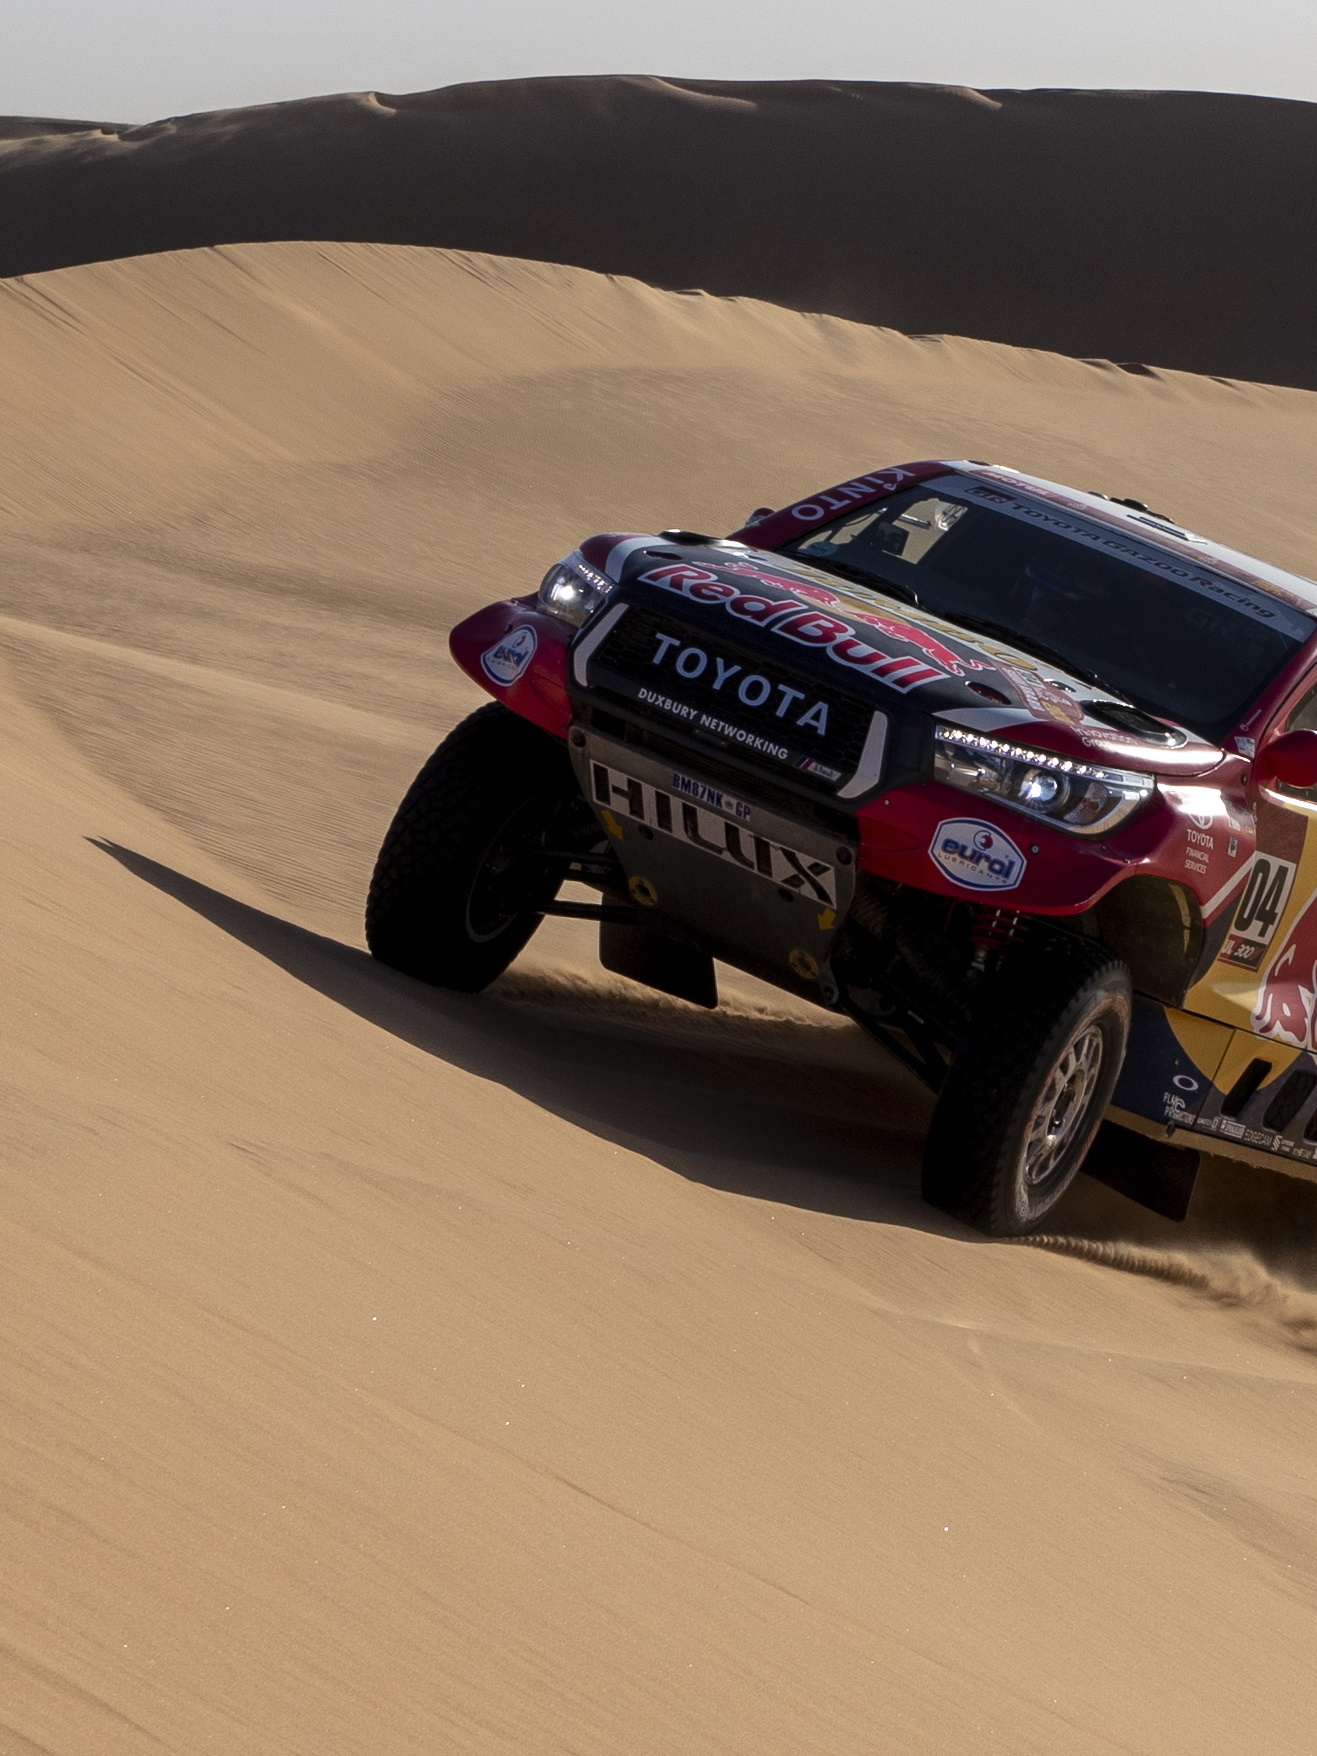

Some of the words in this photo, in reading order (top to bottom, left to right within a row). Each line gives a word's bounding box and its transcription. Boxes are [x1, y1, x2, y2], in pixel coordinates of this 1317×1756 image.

[791, 467, 916, 520] KINTO
[1011, 502, 1101, 541] TOYOTA
[1102, 540, 1190, 578] GAZOO
[1189, 576, 1277, 619] Racing
[638, 564, 808, 627] Red
[771, 611, 951, 693] Bull
[651, 633, 830, 737] TOYOTA
[637, 687, 699, 720] DUXBURY
[699, 713, 789, 760] NETWORKING
[672, 772, 725, 810] BM87NK
[734, 800, 752, 823] GP
[591, 761, 835, 907] HILUX
[941, 837, 1016, 881] eurol
[1186, 828, 1214, 850] TOYOTA
[937, 852, 1008, 885] LUBRICANTS
[1233, 858, 1289, 939] 04
[1243, 1128, 1274, 1147] EDGECAM
